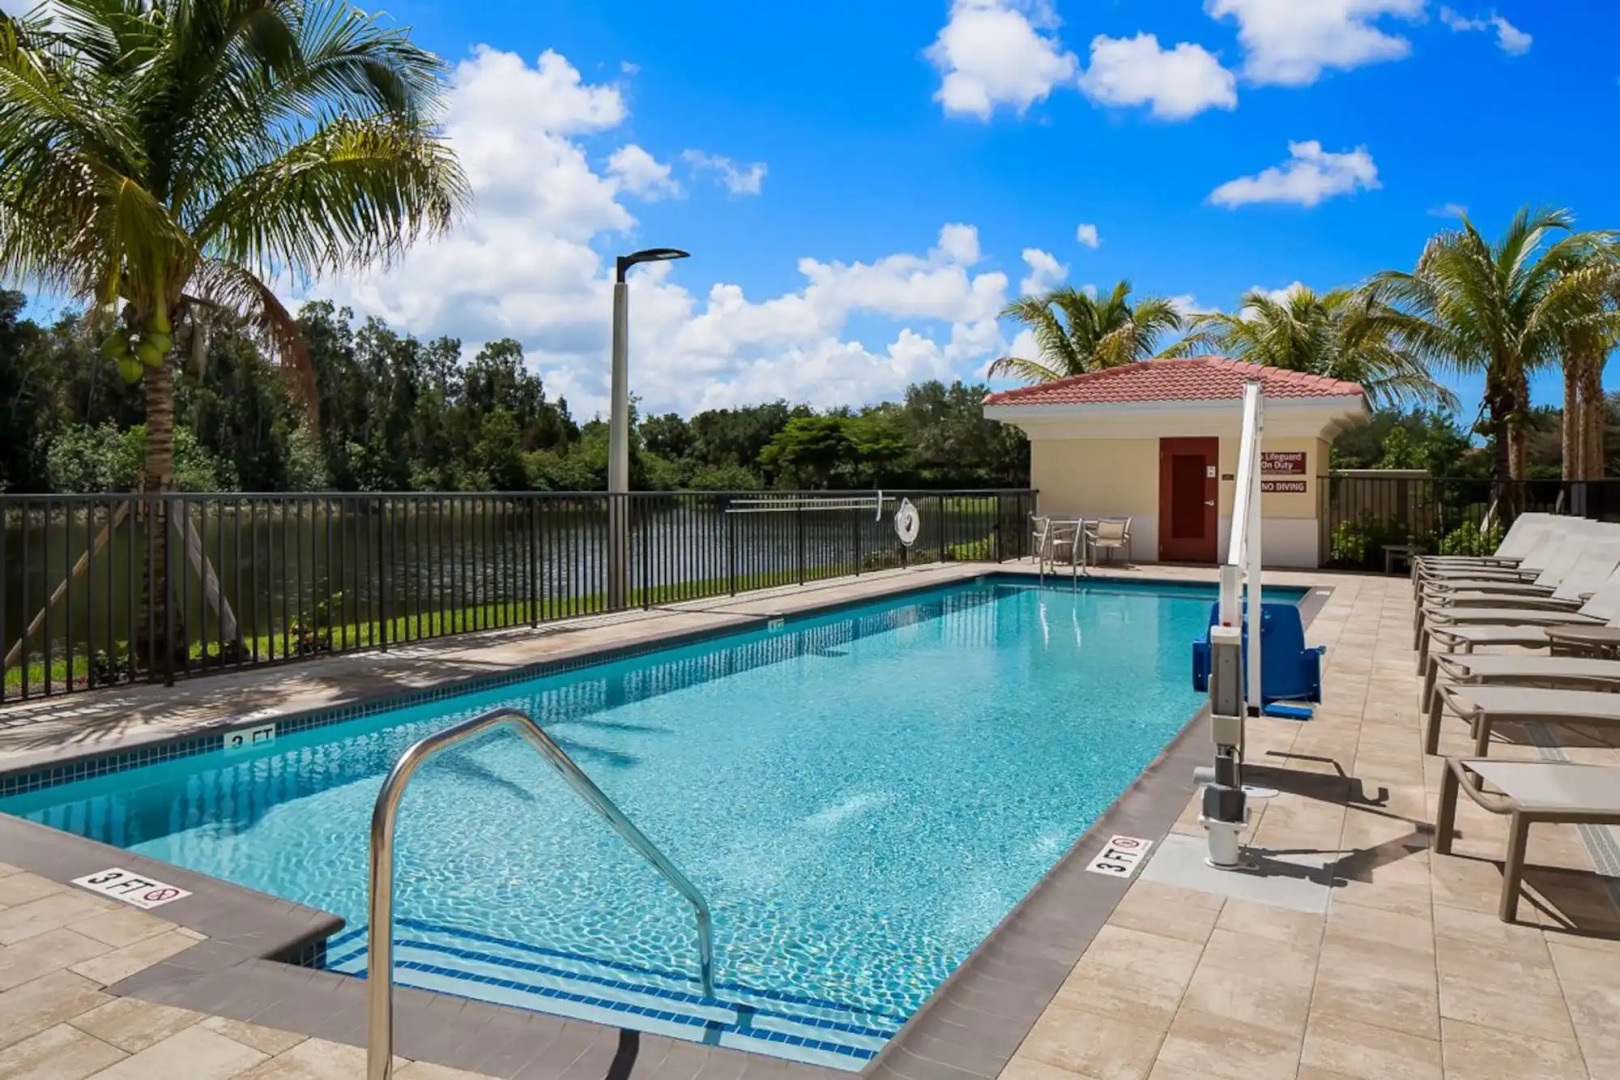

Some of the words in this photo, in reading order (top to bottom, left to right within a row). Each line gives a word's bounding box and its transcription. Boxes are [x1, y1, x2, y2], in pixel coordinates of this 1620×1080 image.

[1265, 453, 1302, 462] Lifeguard
[1261, 461, 1273, 469] On
[1274, 461, 1293, 470] Duty
[1261, 482, 1275, 491] NO
[1276, 482, 1304, 491] DIVING
[1103, 848, 1138, 863] FT
[1096, 862, 1127, 873] 3
[87, 872, 123, 884] 3
[105, 878, 155, 895] FT
